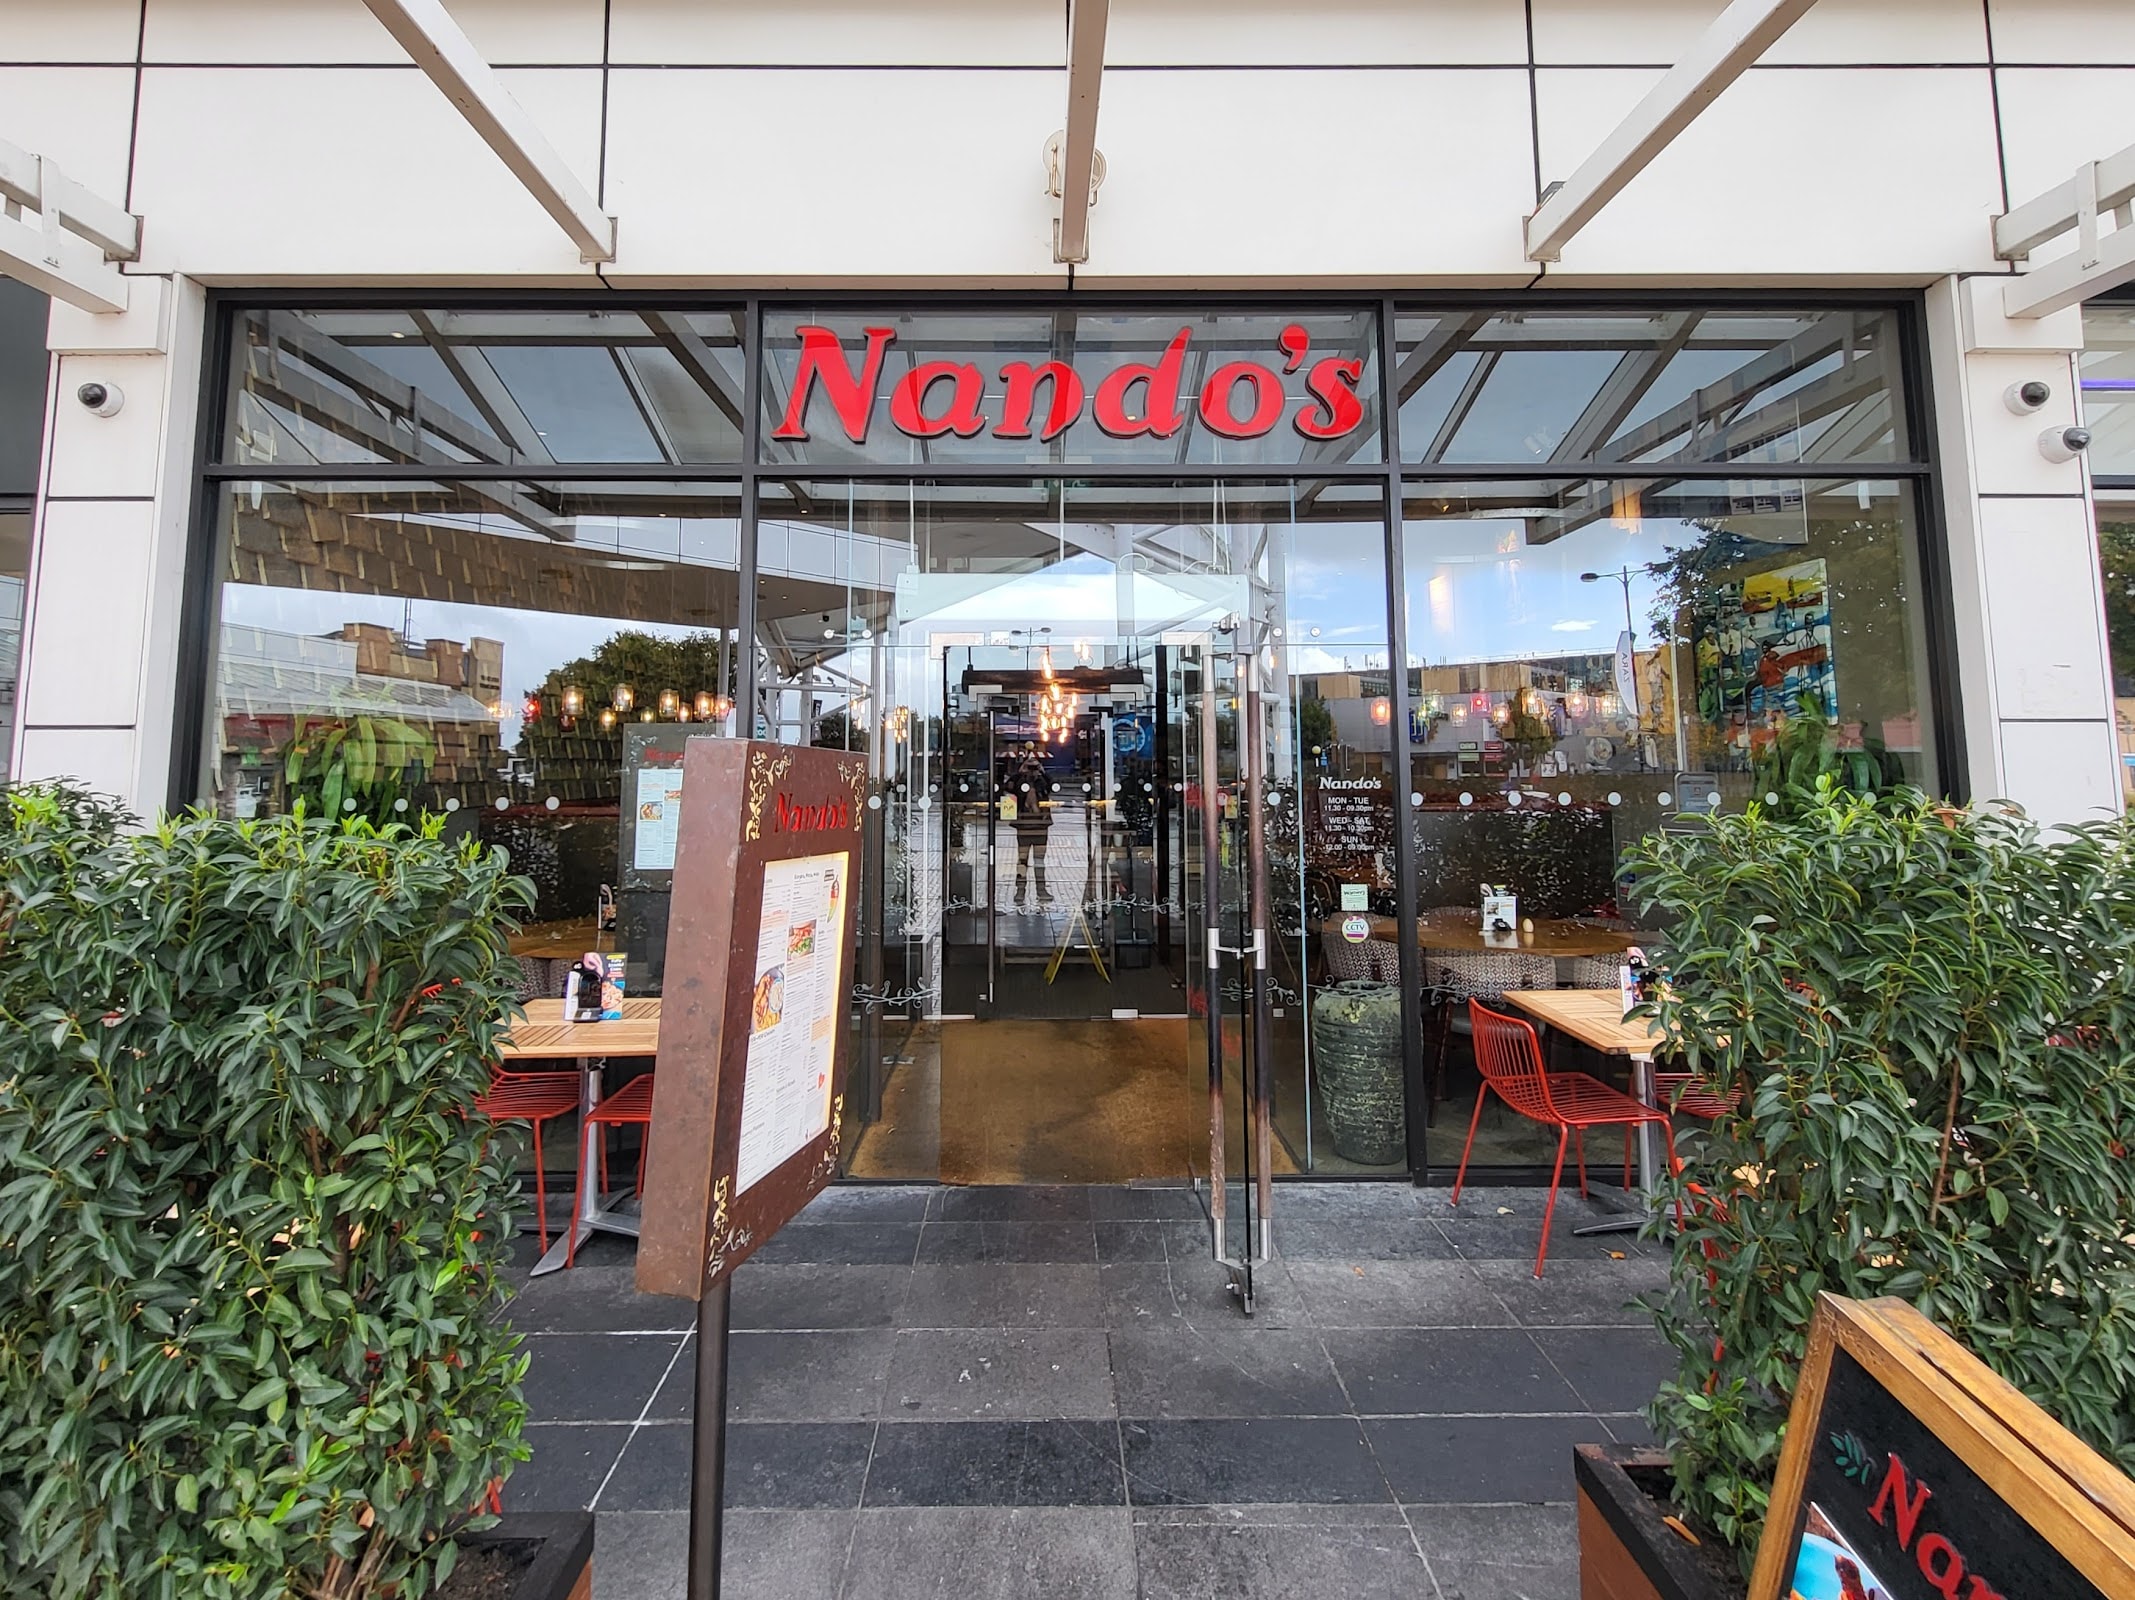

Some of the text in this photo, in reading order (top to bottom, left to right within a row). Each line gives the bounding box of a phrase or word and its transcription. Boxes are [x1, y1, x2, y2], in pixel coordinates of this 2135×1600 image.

[771, 324, 1364, 444] Nando's
[1319, 776, 1382, 790] Nando's
[1327, 796, 1347, 805] MON
[1353, 796, 1370, 805] TUE
[775, 792, 848, 833] Nando's
[1328, 816, 1348, 825] WED
[1353, 816, 1370, 825] SAT
[1341, 835, 1359, 843] SUN
